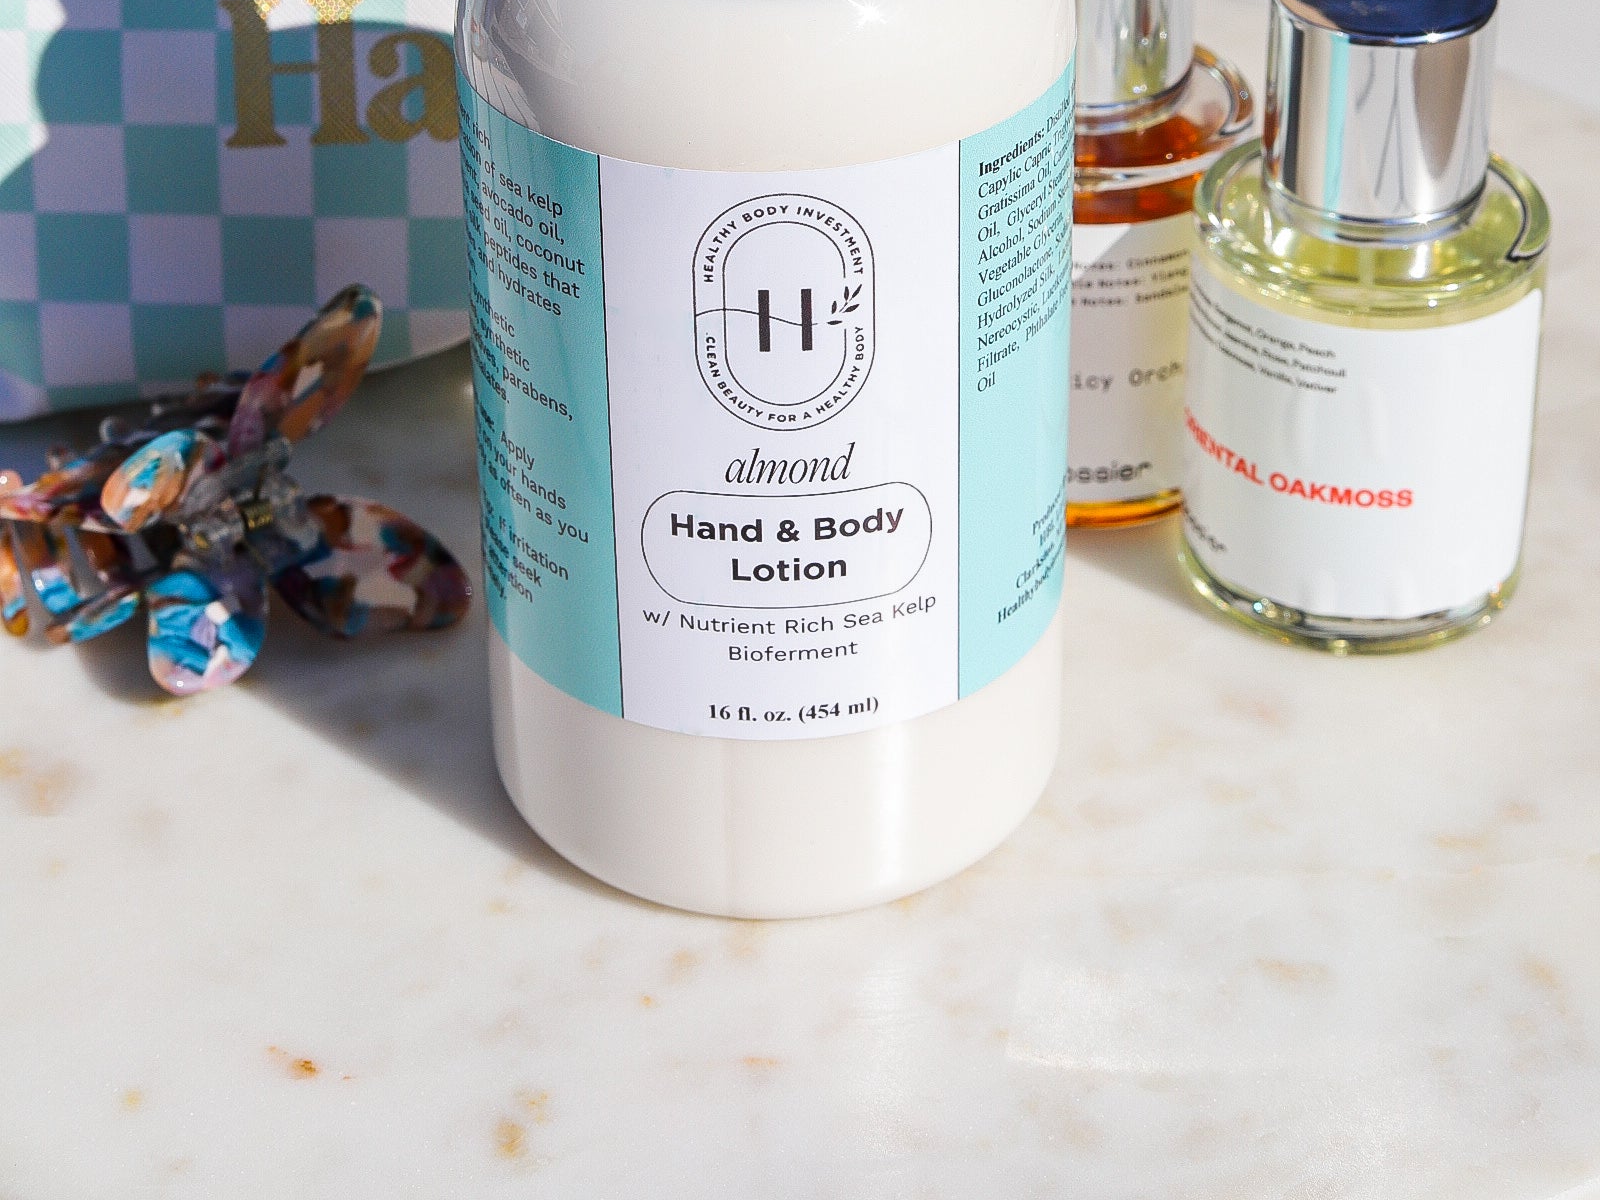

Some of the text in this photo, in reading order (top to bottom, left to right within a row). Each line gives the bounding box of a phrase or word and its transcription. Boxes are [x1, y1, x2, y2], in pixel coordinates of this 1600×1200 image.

[472, 122, 491, 150] rich
[978, 126, 1046, 178] Ingredients:
[484, 160, 496, 178] of
[499, 173, 523, 198] sea
[527, 185, 563, 218] kelp
[977, 178, 1036, 220] Gratissima
[1037, 160, 1052, 184] Oil,
[978, 166, 1022, 199] Capylic
[1024, 142, 1052, 173] Capric
[481, 182, 534, 227] avocado
[538, 221, 565, 245] oil,
[977, 220, 1001, 243] Oil,
[1007, 185, 1047, 227] Glyceryl
[977, 227, 1025, 266] Alcohol,
[1028, 199, 1057, 235] Sodium
[483, 231, 538, 280] peptides
[542, 270, 580, 299] that
[493, 217, 512, 242] oil,
[516, 234, 586, 275] coconut
[703, 205, 864, 283] HEALTHY BODY INVESTMENT
[978, 245, 1032, 285] Vegetable
[498, 264, 562, 316] hydrates
[977, 247, 1054, 307] Gluconolactone,
[977, 279, 1039, 330] Hydrolyzed
[977, 302, 1041, 351] Nereocystic,
[717, 381, 764, 418] BEAUTY
[767, 412, 797, 423] FOR
[802, 411, 813, 420] A
[815, 364, 861, 413] HEALTHY
[854, 325, 865, 361] BODY
[977, 340, 1021, 373] Filtrate,
[977, 371, 996, 393] Oil
[502, 365, 573, 421] parabens,
[500, 430, 535, 471] Apply
[725, 441, 856, 485] almond
[493, 446, 517, 476] your
[521, 469, 567, 510] hands
[1268, 471, 1414, 508] OAKMOSS
[500, 477, 532, 513] often
[535, 507, 553, 526] as
[557, 519, 589, 544] you
[670, 506, 905, 544] Hand & Body
[509, 525, 569, 580] irritation
[512, 555, 542, 588] seek
[731, 556, 848, 583] Lotion
[642, 594, 937, 636] w/ Nutrient Rich Sea Kelp
[728, 640, 859, 663] Bioferment
[708, 696, 879, 724] 16 fl. oz. (454 ml)
